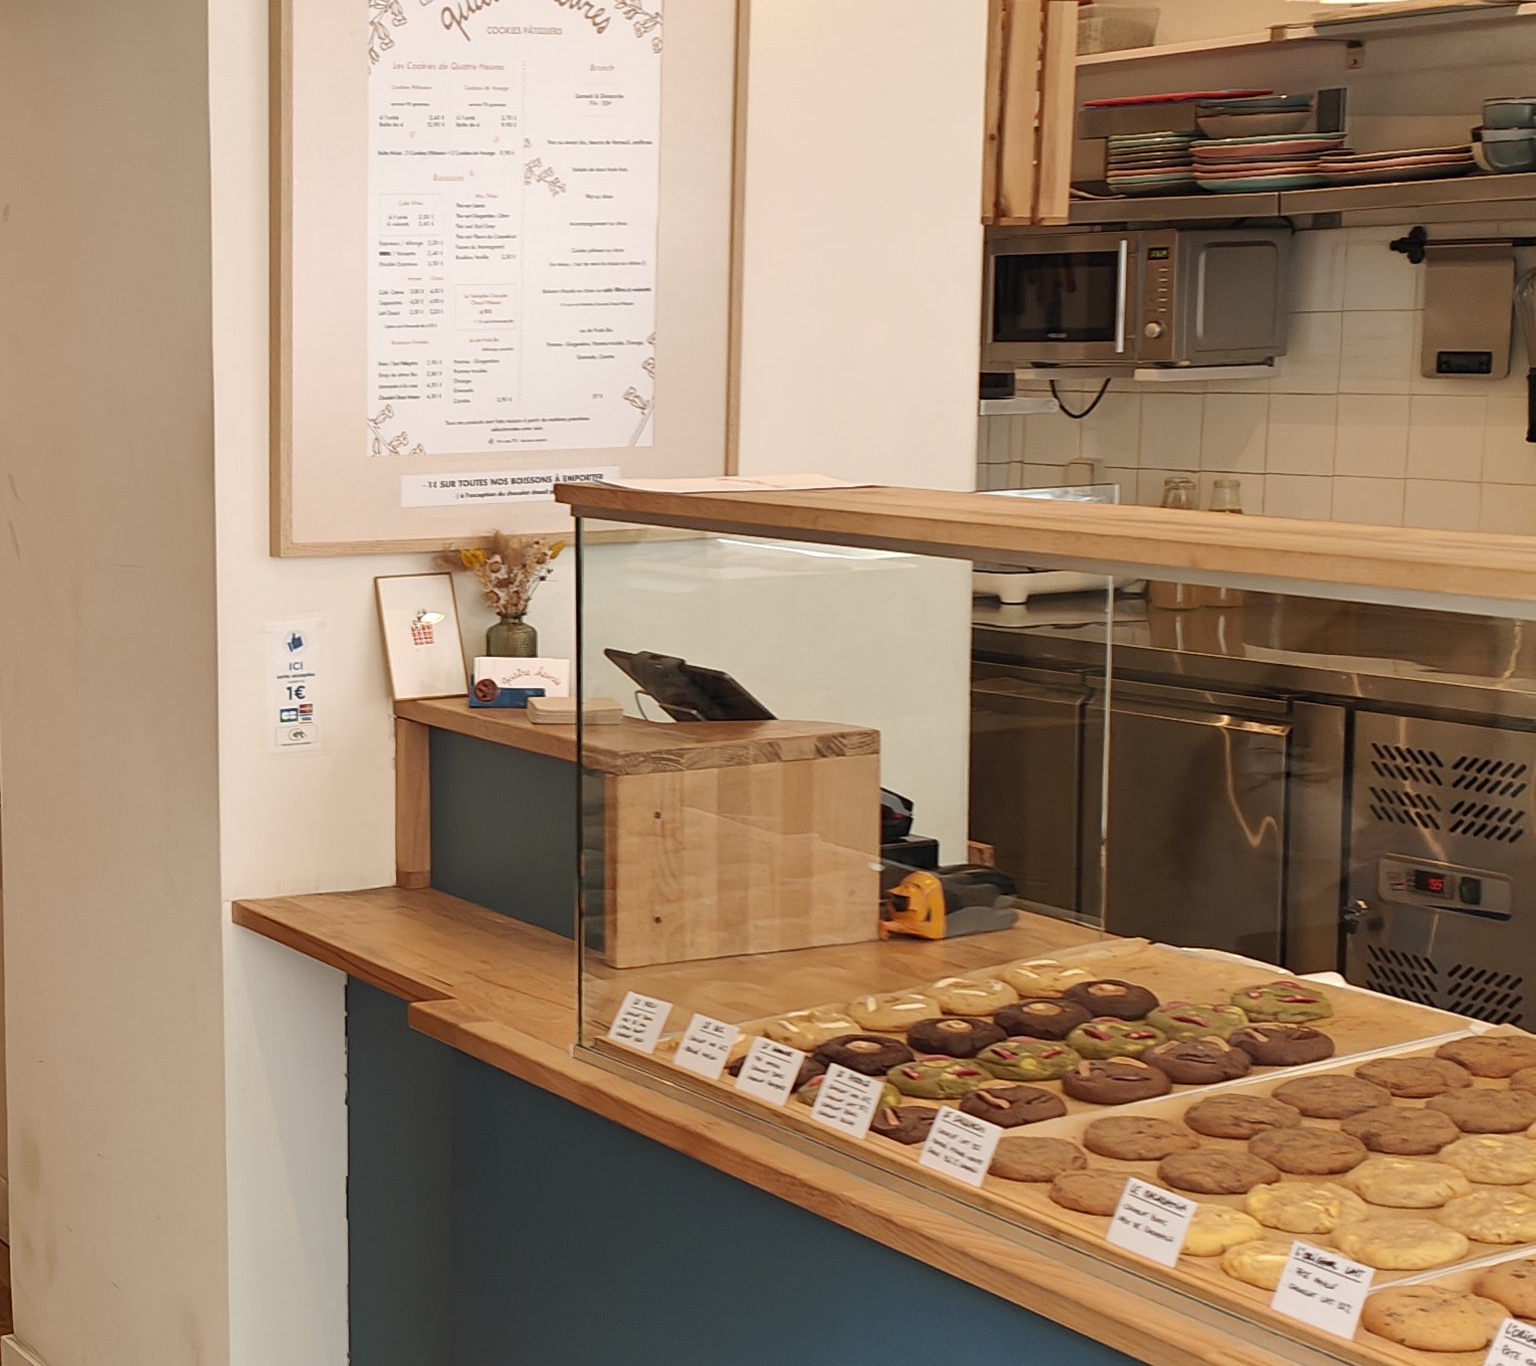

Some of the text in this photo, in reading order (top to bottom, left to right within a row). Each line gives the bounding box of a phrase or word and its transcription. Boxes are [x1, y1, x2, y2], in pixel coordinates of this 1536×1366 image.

[439, 480, 456, 489] SUR
[458, 478, 489, 488] TOUTES
[490, 477, 508, 486] NOS
[511, 475, 553, 485] BOISSONS
[289, 661, 304, 671] ICI
[286, 685, 307, 701] 1€
